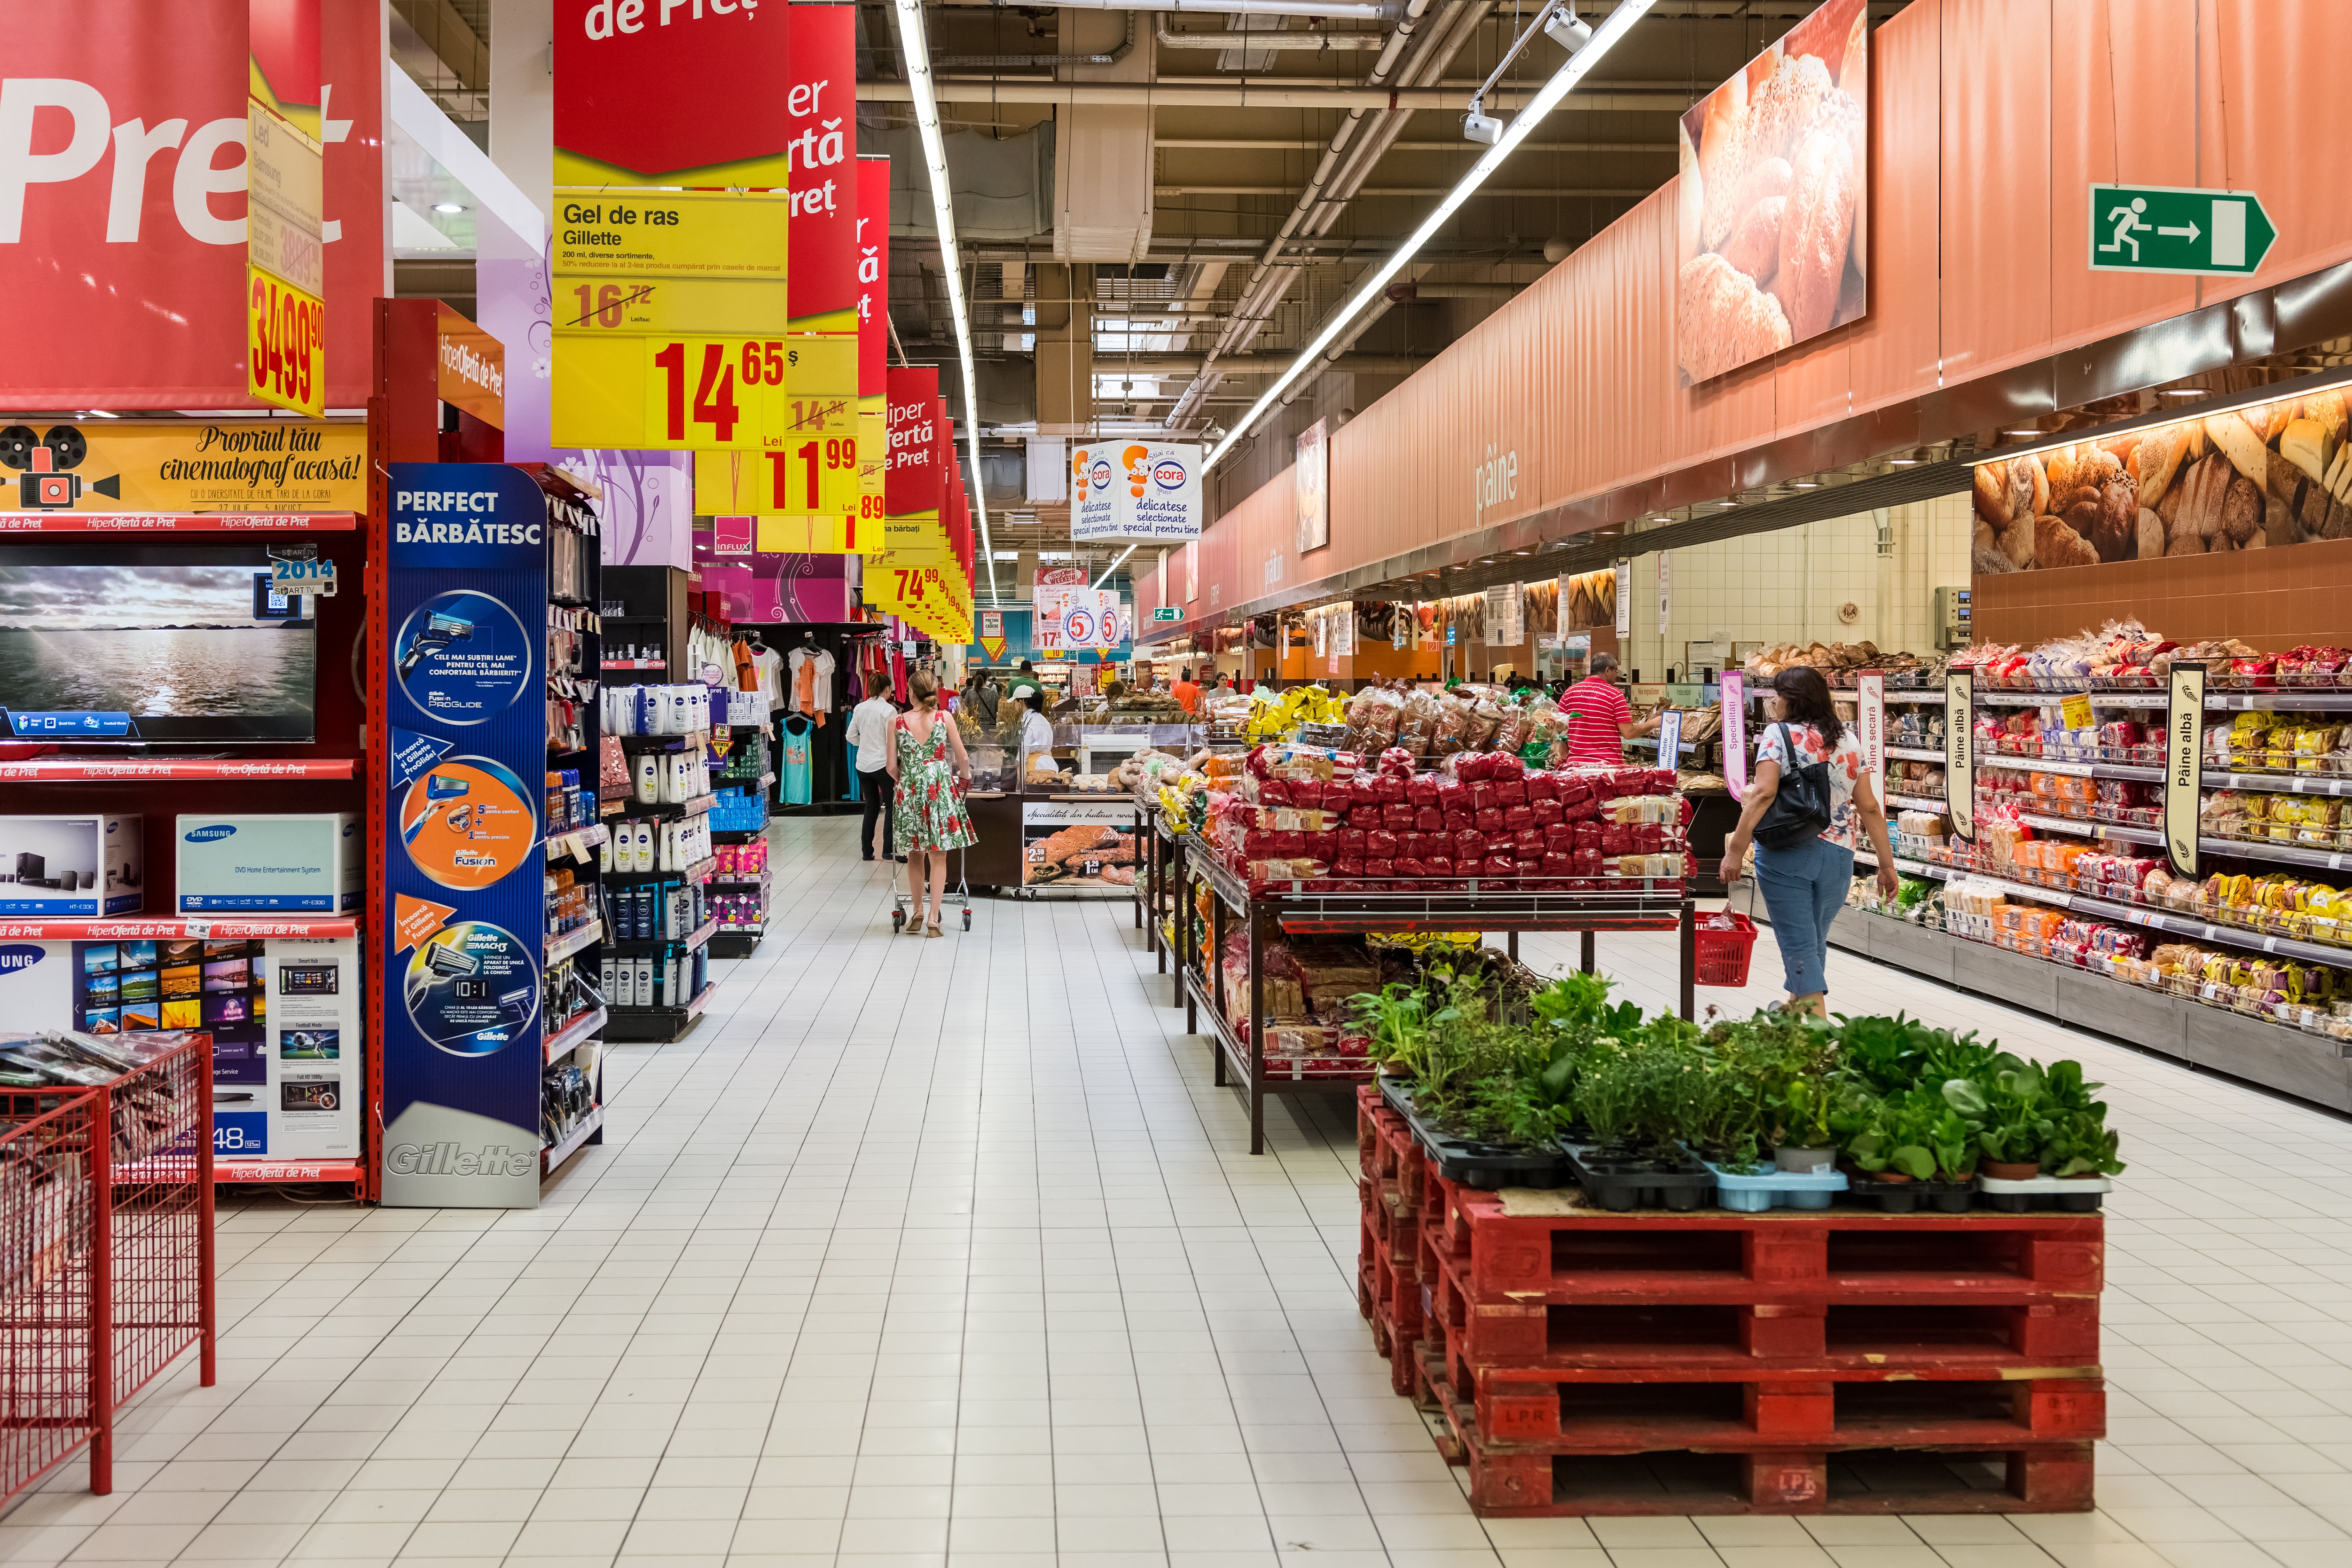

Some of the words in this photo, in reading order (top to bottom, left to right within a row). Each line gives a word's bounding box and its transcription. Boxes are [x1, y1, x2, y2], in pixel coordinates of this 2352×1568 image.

[254, 115, 268, 148] Led
[254, 151, 281, 189] Samsung
[564, 204, 601, 224] Gel
[609, 205, 637, 225] de
[644, 210, 679, 226] ras
[563, 230, 622, 246] Gillette
[577, 251, 587, 260] ml,
[616, 253, 655, 261] sortimente,
[672, 263, 705, 272] cumpărat
[707, 264, 720, 272] prin
[441, 333, 479, 384] HiperOfertă
[480, 357, 488, 389] de
[196, 426, 286, 453] Propriul
[290, 427, 322, 452] tău
[763, 436, 782, 446] Lei
[886, 420, 933, 454] fertă
[897, 449, 930, 469] Preț
[1148, 450, 1164, 461] Stiai
[160, 453, 295, 488] cinematograf
[293, 454, 361, 480] acasă!
[1093, 469, 1110, 480] cora
[1155, 470, 1184, 480] cora
[191, 489, 198, 499] CU
[208, 489, 244, 499] DIVERSITATE
[248, 489, 255, 499] DE
[258, 489, 272, 499] FILME
[276, 489, 289, 499] TARI
[292, 489, 299, 499] DE
[302, 489, 310, 499] LA
[1476, 442, 1518, 527] pâine
[397, 491, 498, 512] PERFECT
[1081, 501, 1111, 513] delicatese
[1136, 497, 1188, 512] delicatese
[221, 516, 273, 529] HiperOfertă
[276, 517, 288, 526] de
[290, 517, 310, 529] Preț
[1081, 513, 1111, 524] selectionate
[1137, 511, 1187, 523] selectionate
[396, 518, 541, 545] BĂRBĂTESC
[894, 524, 920, 534] bărbați
[1073, 524, 1090, 539] special
[1092, 525, 1108, 538] pentru
[1109, 522, 1118, 531] tine
[1123, 522, 1152, 535] special
[1155, 524, 1183, 536] pentru
[1185, 524, 1199, 534] tine
[276, 559, 334, 580] 2014
[1728, 701, 1739, 750] Specialități
[1866, 706, 1877, 741] secară
[1955, 708, 1965, 734] albă
[2179, 712, 2193, 743] albă
[394, 737, 424, 760] Încearcă
[407, 744, 431, 763] Gillette
[1955, 736, 1965, 769] Pâine
[404, 750, 436, 775] ProGlide!
[1868, 745, 1877, 773] Pâine
[2177, 746, 2191, 787] Pâine
[1070, 809, 1083, 818] din
[456, 857, 495, 865] Fusion
[398, 904, 428, 927] Încearcă
[410, 911, 435, 930] Gillette
[411, 921, 436, 940] Fusion!
[467, 933, 498, 942] Gillette
[477, 1032, 509, 1041] Gillette
[386, 1142, 532, 1178] Gillette
[231, 1167, 284, 1179] HiperOfertă
[286, 1168, 298, 1177] de
[300, 1167, 321, 1179] Preț
